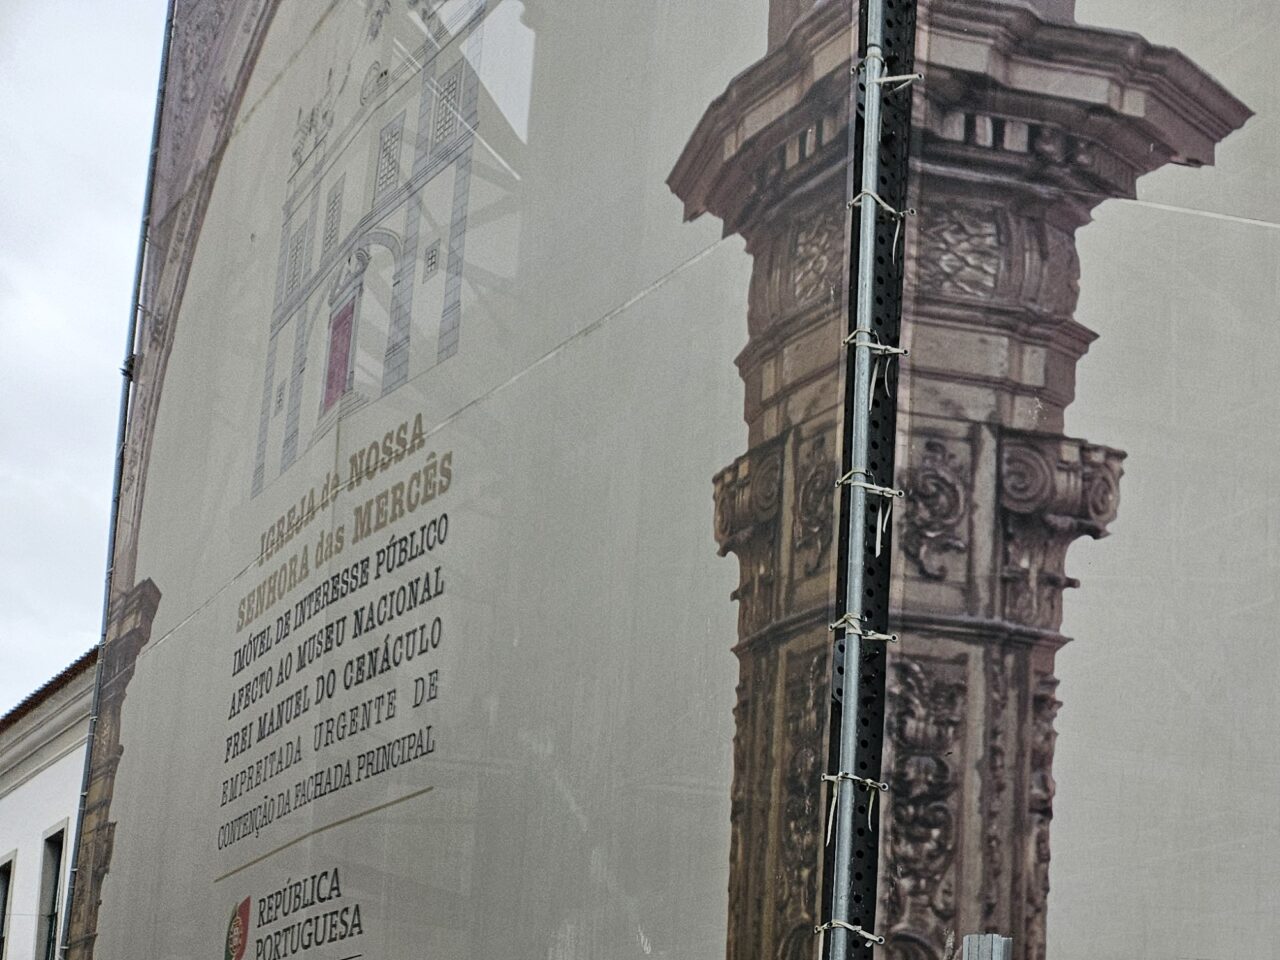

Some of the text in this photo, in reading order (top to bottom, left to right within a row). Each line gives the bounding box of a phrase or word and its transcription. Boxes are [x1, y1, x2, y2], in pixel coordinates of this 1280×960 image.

[347, 412, 426, 492] NOSSA
[232, 513, 448, 677] IMÓVEL DE INTERESSE PÚBLICO
[236, 451, 453, 633] SENHORA das MERCÊS
[224, 616, 442, 763] FREI MANUEL DO CENÁCULO
[228, 566, 444, 720] AFECTO AO MUSEU NACIONAL
[217, 725, 435, 850] CONTENÇÃO DA FACHADA PRINCIPAL
[220, 669, 438, 807] EMPREITADA URGENTE DE
[256, 867, 342, 929] REPÚBLICA
